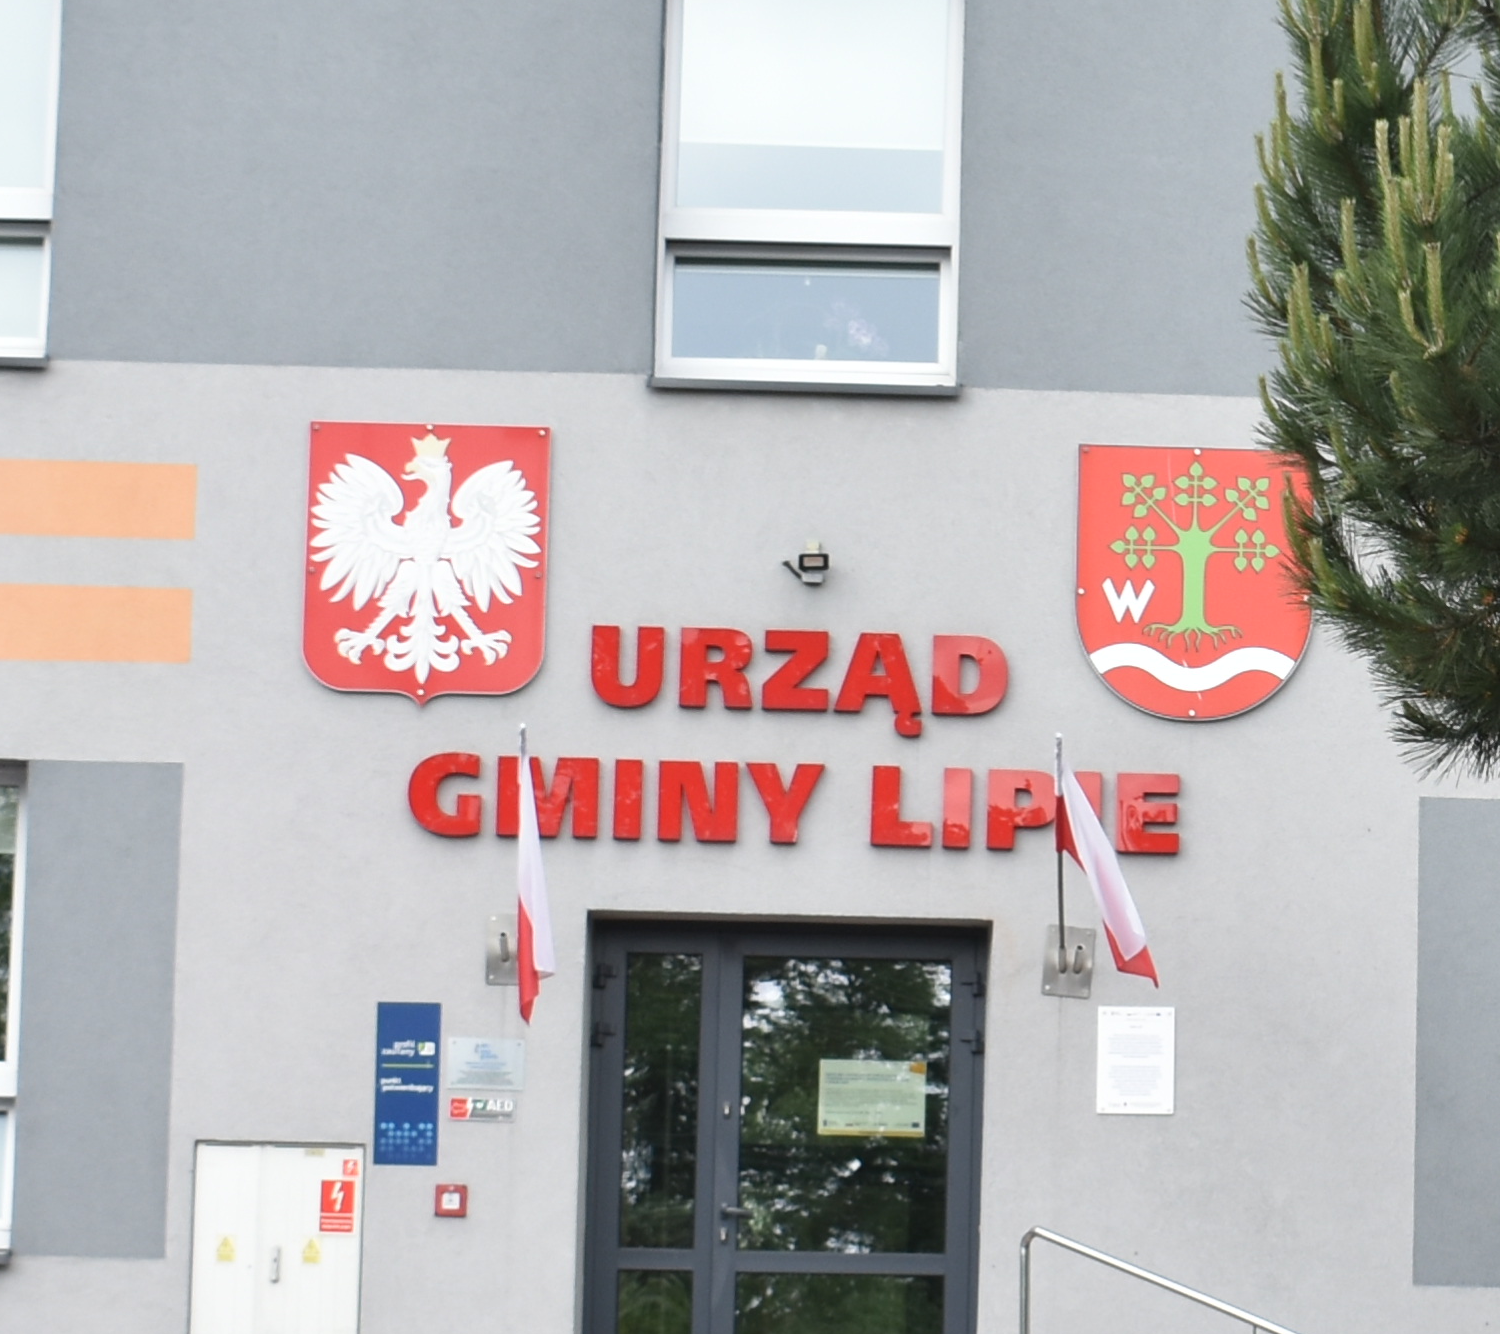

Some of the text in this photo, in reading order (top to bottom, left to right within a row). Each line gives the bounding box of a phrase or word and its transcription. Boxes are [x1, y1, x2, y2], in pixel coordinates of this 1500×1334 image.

[1101, 576, 1156, 624] W
[591, 625, 1008, 737] URZĄD
[408, 752, 826, 844] GMINY
[486, 1098, 514, 1112] AED
